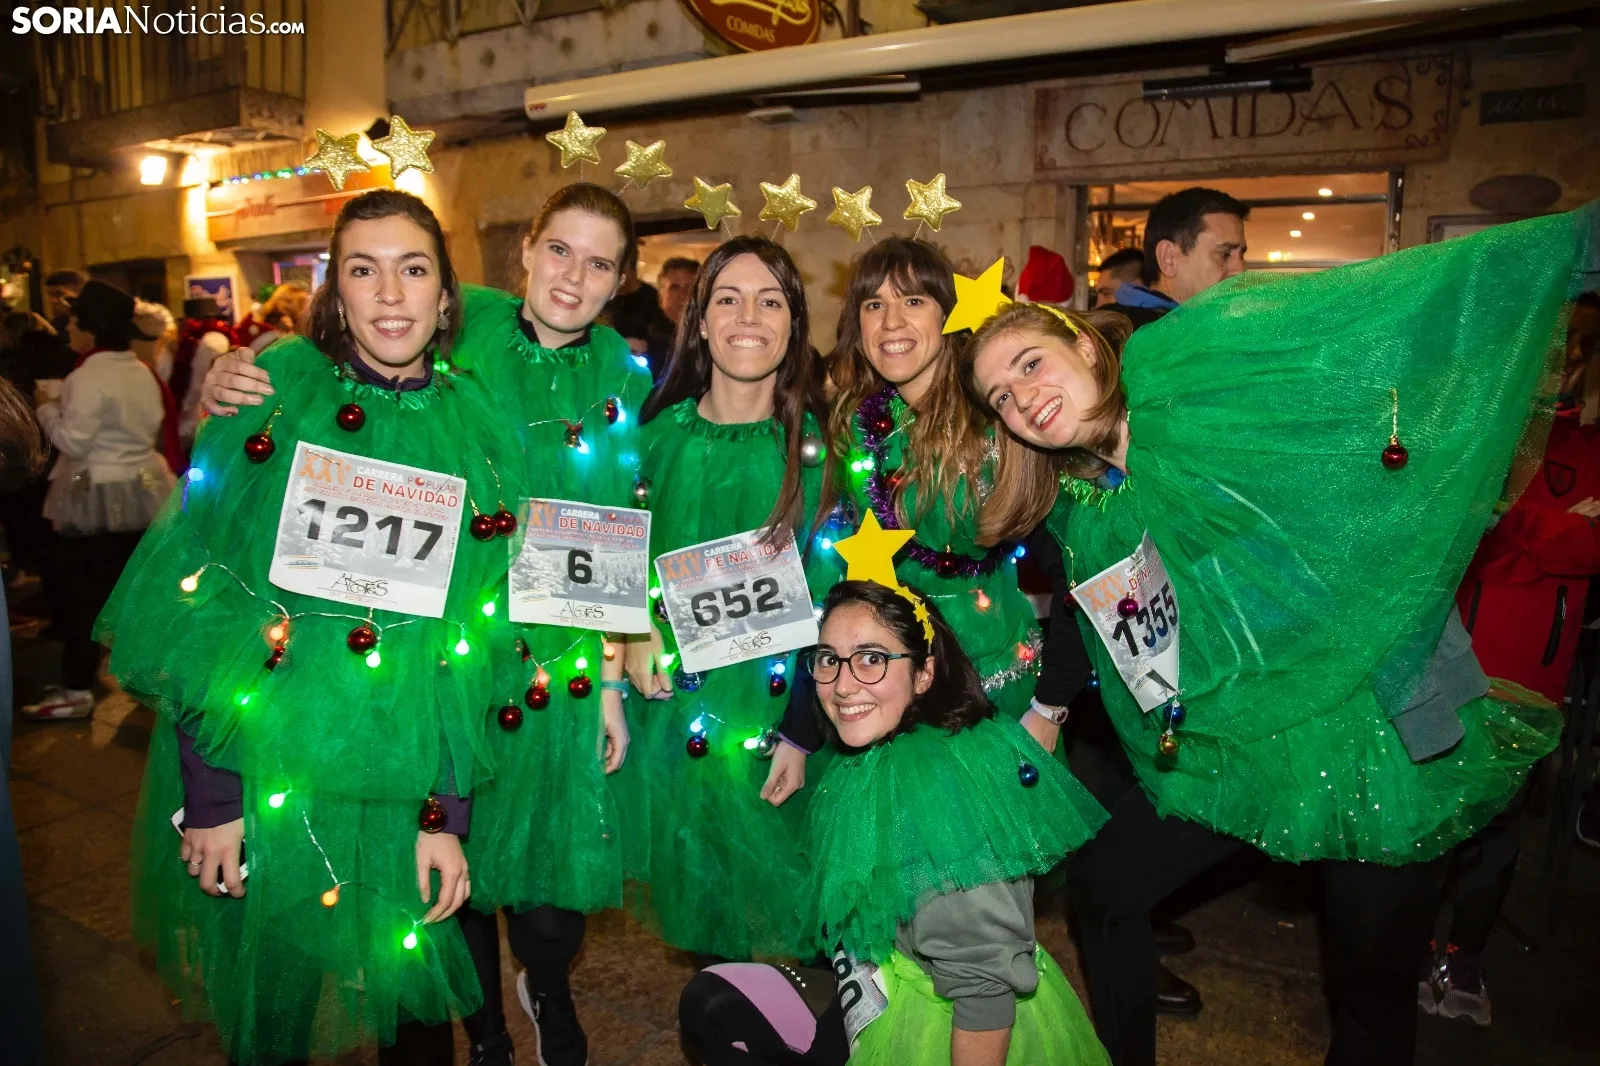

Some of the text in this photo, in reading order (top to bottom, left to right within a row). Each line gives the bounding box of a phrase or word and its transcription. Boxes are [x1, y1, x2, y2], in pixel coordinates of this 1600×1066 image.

[726, 15, 776, 43] COMIDAS
[1064, 73, 1414, 153] COMIDAS
[299, 449, 352, 485] XXV
[357, 465, 404, 483] CARRERA
[353, 475, 375, 491] DE
[382, 481, 459, 508] NAVIDAD
[296, 498, 443, 561] 1217
[559, 516, 578, 529] DE
[582, 520, 645, 538] NAVIDAD
[560, 507, 600, 520] CARRERA
[660, 551, 701, 581] XXV
[704, 542, 743, 557] CARRERA
[705, 556, 726, 570] DE
[568, 549, 593, 585] 6
[691, 577, 784, 627] 652
[1081, 572, 1127, 613] XXV
[1112, 581, 1178, 657] 1355
